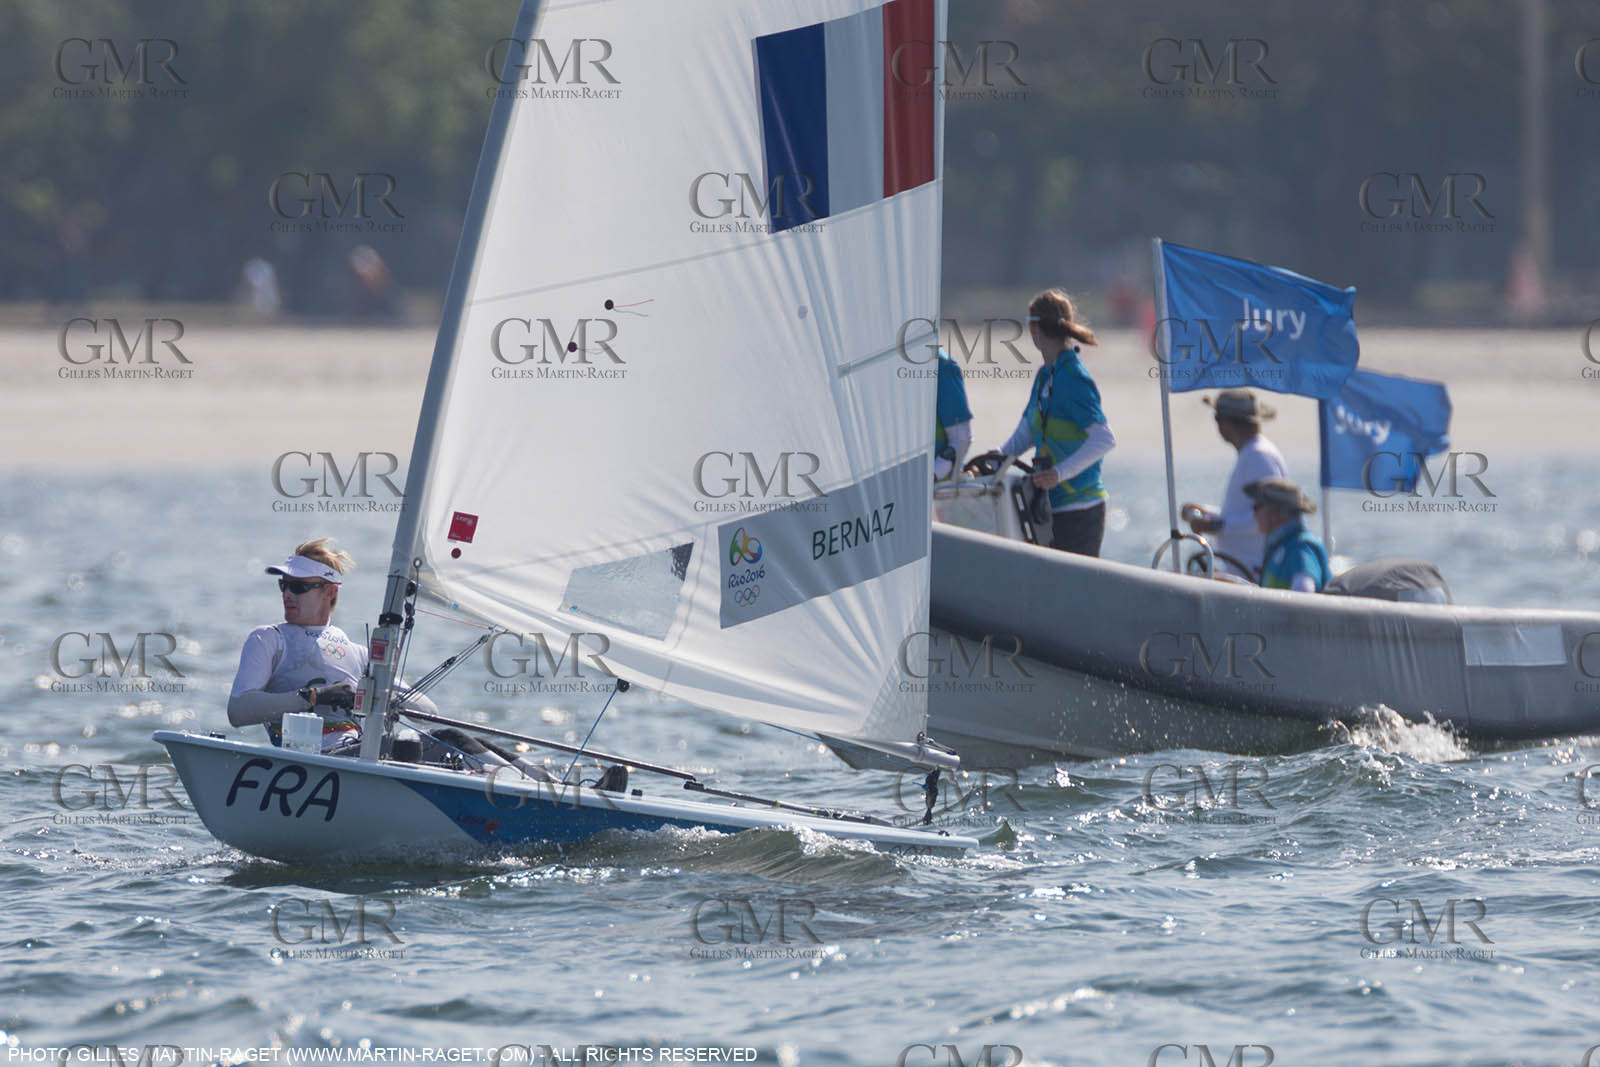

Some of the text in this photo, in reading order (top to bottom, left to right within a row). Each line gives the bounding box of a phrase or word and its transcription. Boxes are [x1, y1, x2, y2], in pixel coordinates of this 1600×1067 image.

[1239, 298, 1306, 340] Jury
[1334, 404, 1392, 445] Jury
[812, 502, 895, 561] BERNAZ
[226, 758, 340, 822] FRA
